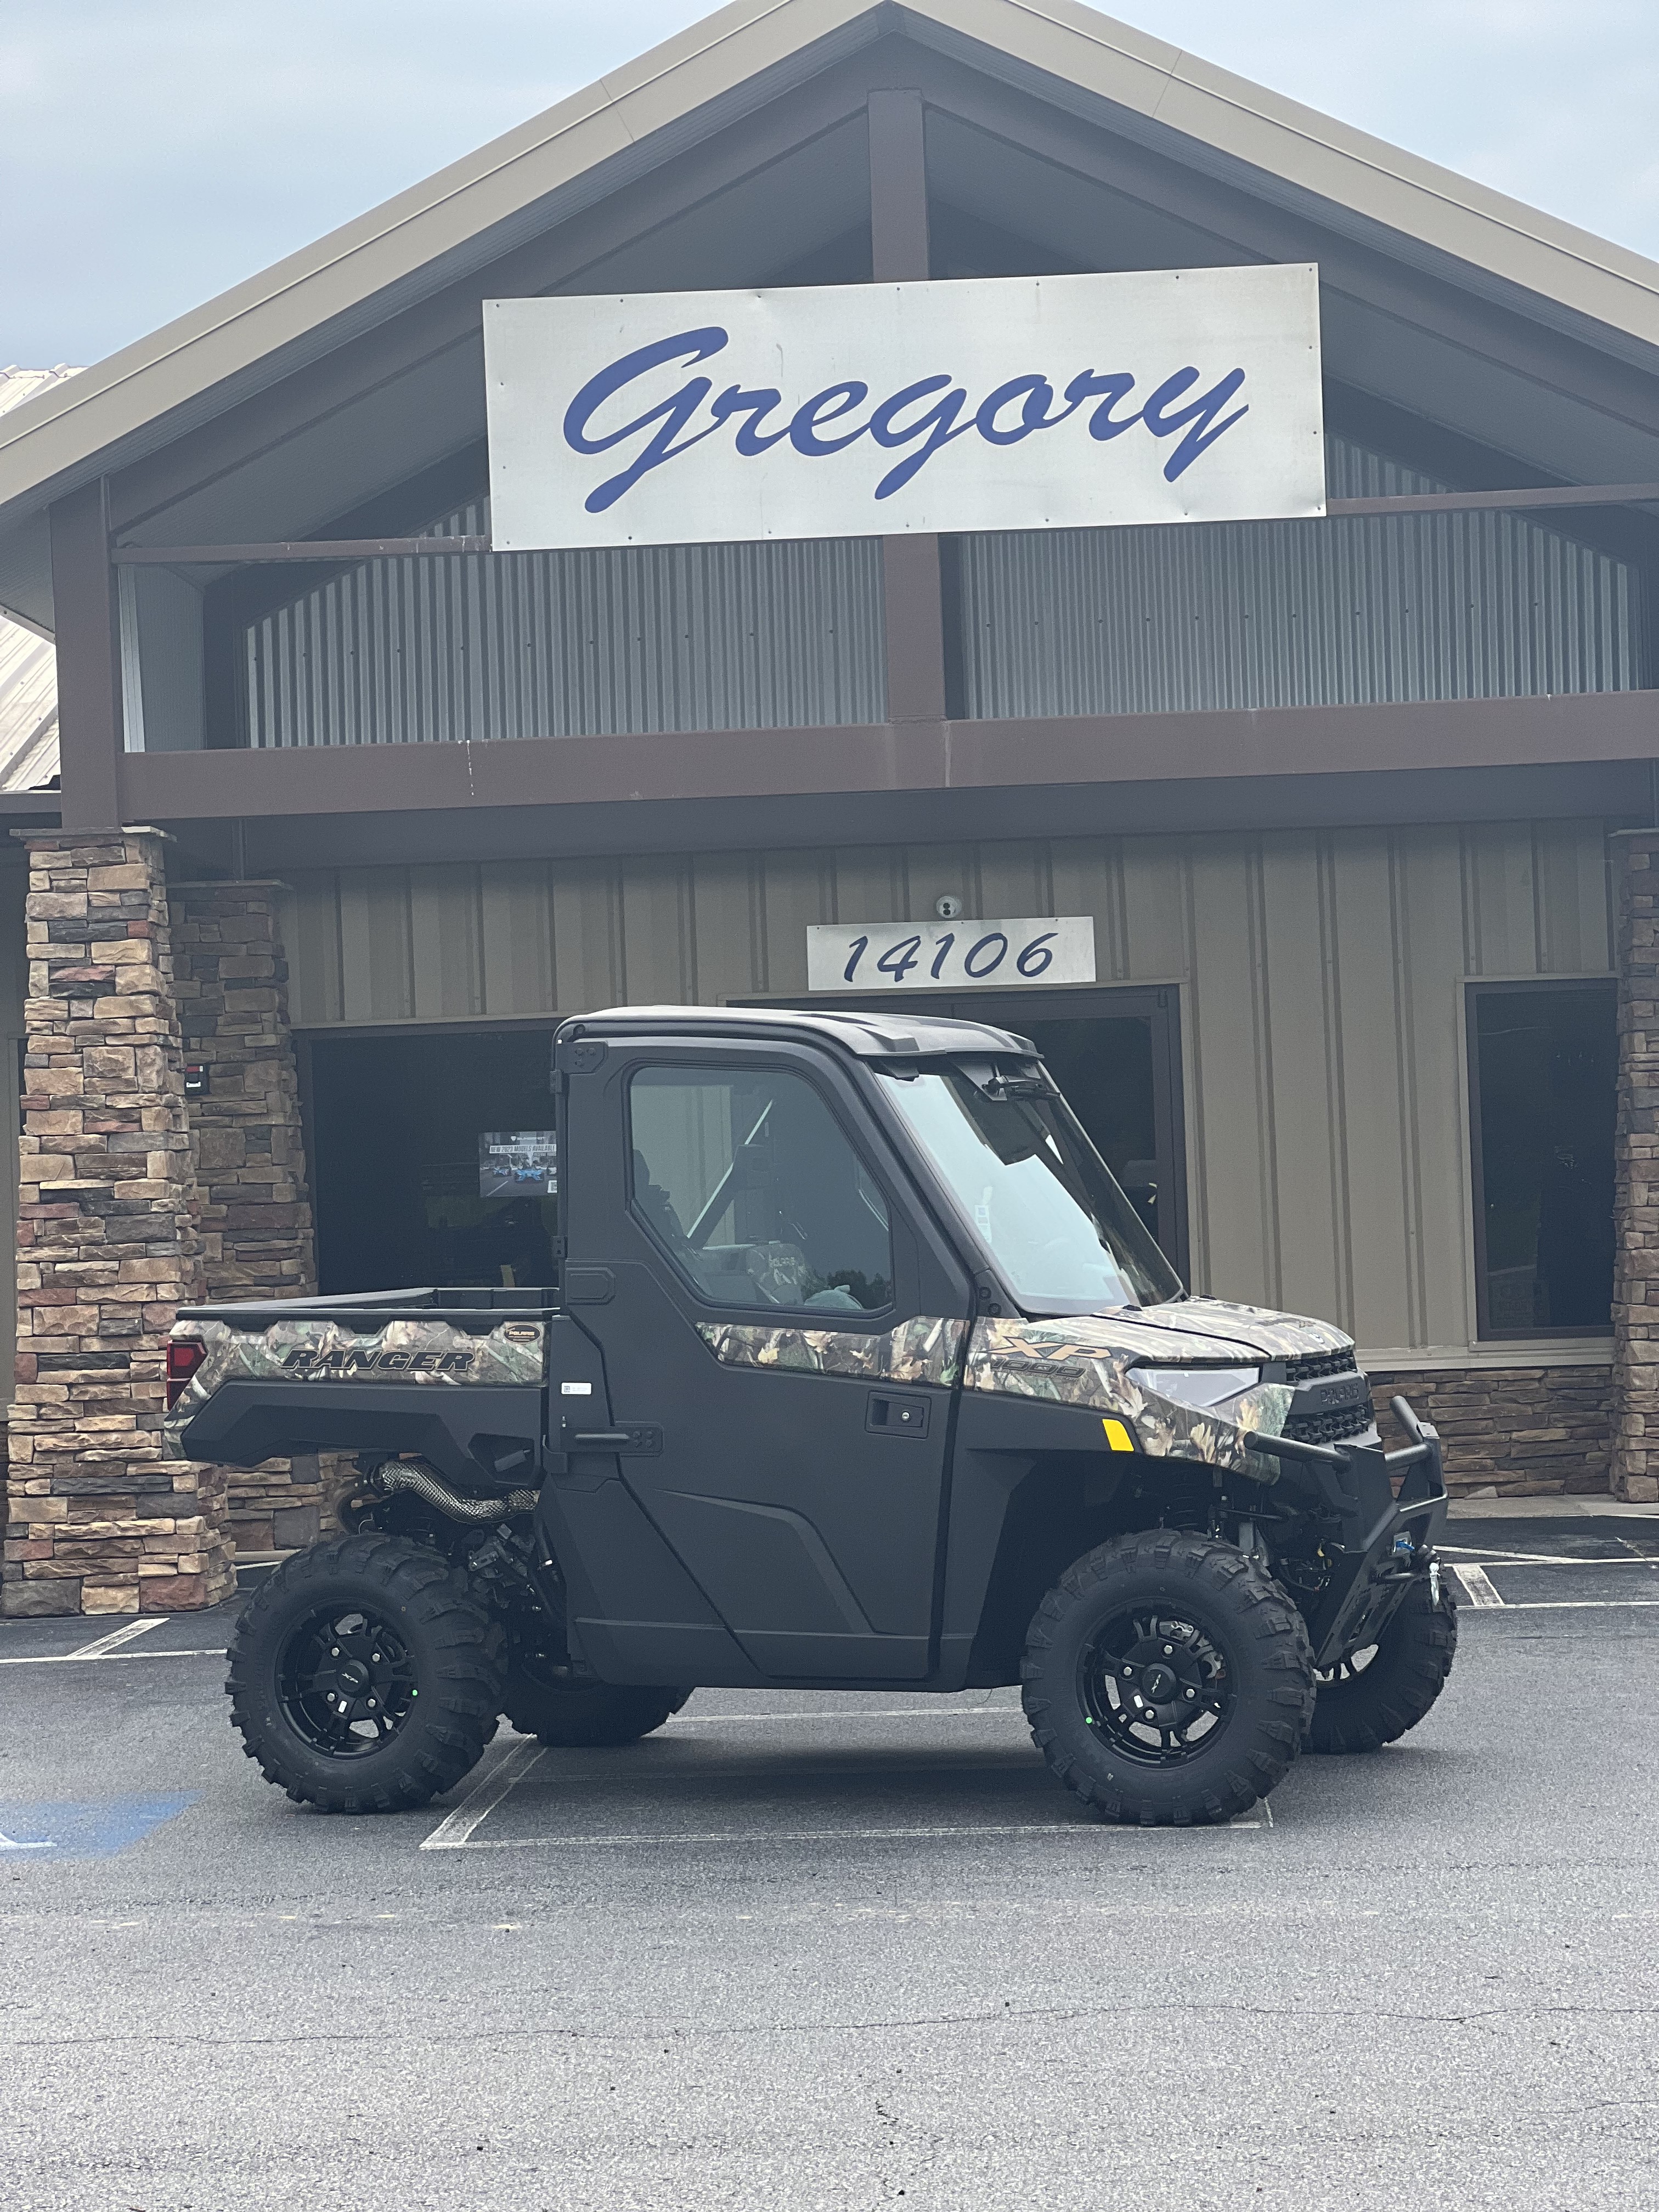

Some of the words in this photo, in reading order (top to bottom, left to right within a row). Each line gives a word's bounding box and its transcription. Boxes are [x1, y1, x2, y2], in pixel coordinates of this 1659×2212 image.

[564, 328, 1248, 512] Gregory
[844, 933, 1059, 982] 14106
[280, 1348, 475, 1371] RANGER
[975, 1335, 1114, 1361] XP
[991, 1358, 1086, 1378] 1000
